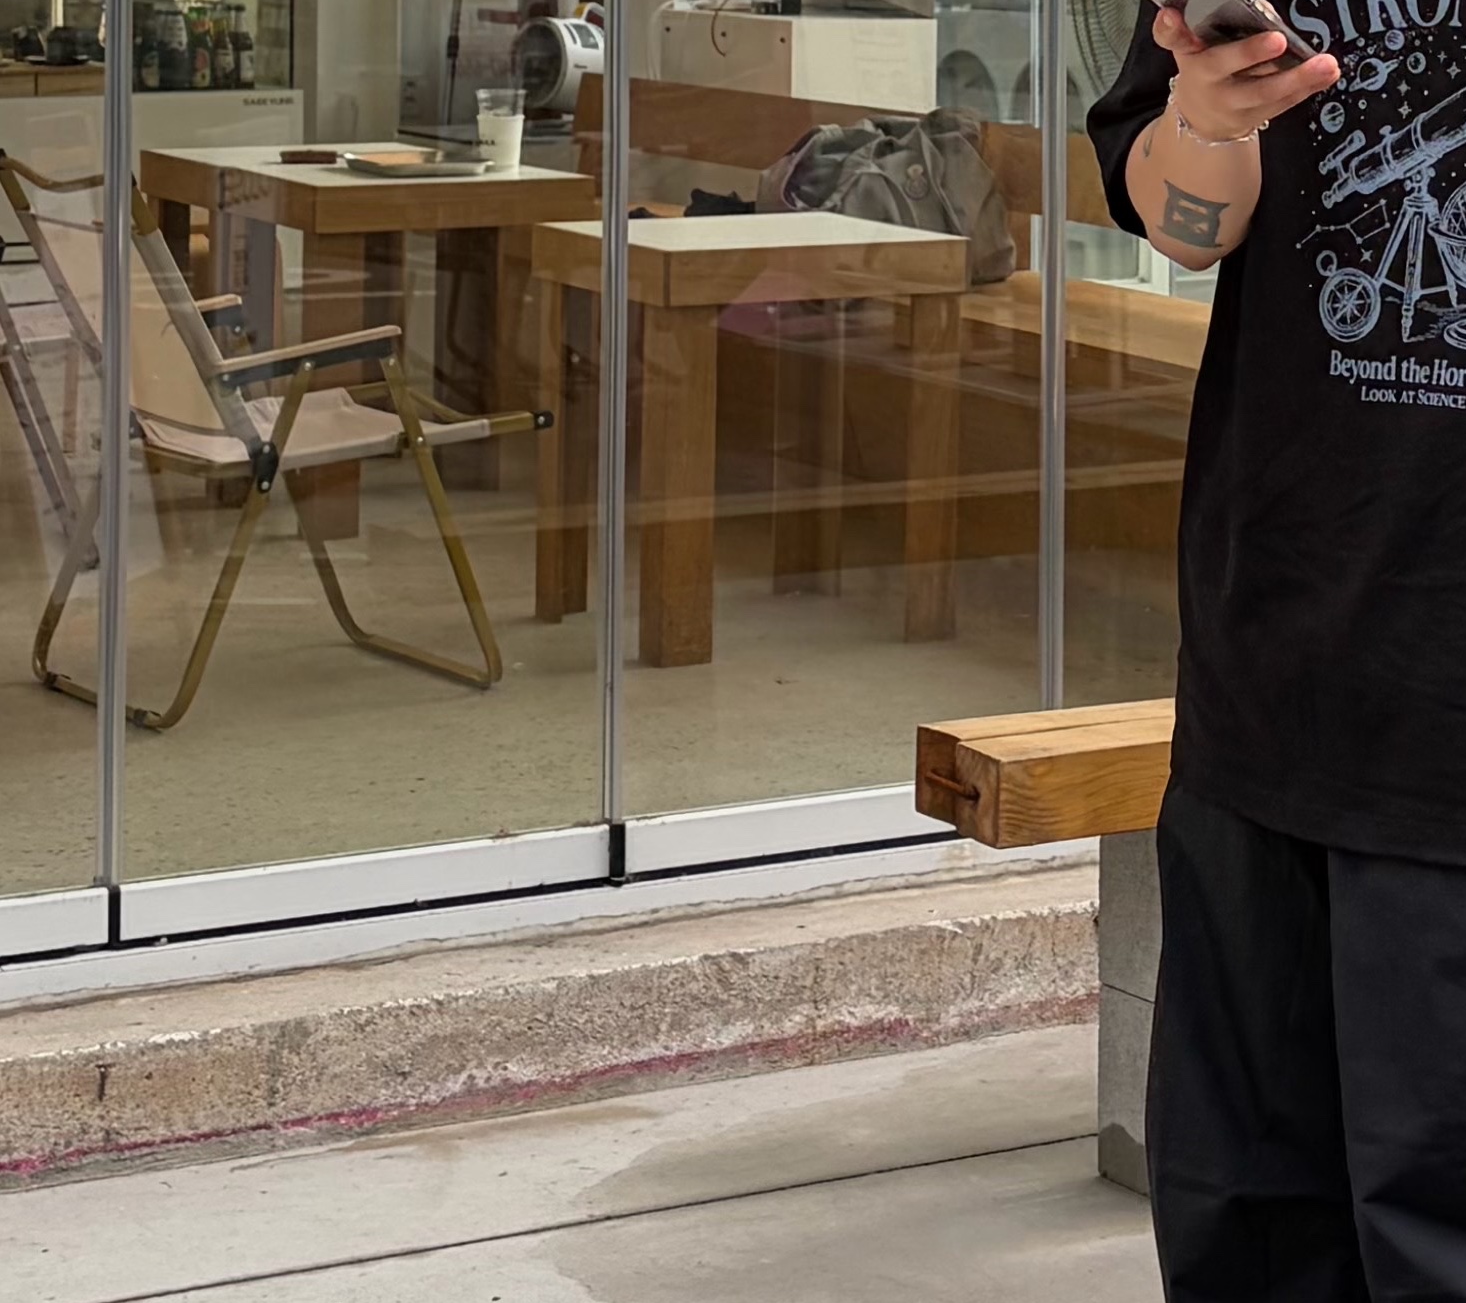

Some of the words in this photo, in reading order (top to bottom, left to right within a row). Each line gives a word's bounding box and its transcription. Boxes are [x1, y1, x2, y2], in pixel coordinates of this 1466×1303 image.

[1329, 349, 1396, 385] Beyond
[1401, 357, 1430, 384] the
[1360, 385, 1397, 403] LOOK
[1399, 390, 1416, 404] AT
[1417, 389, 1466, 409] SCIENCE
